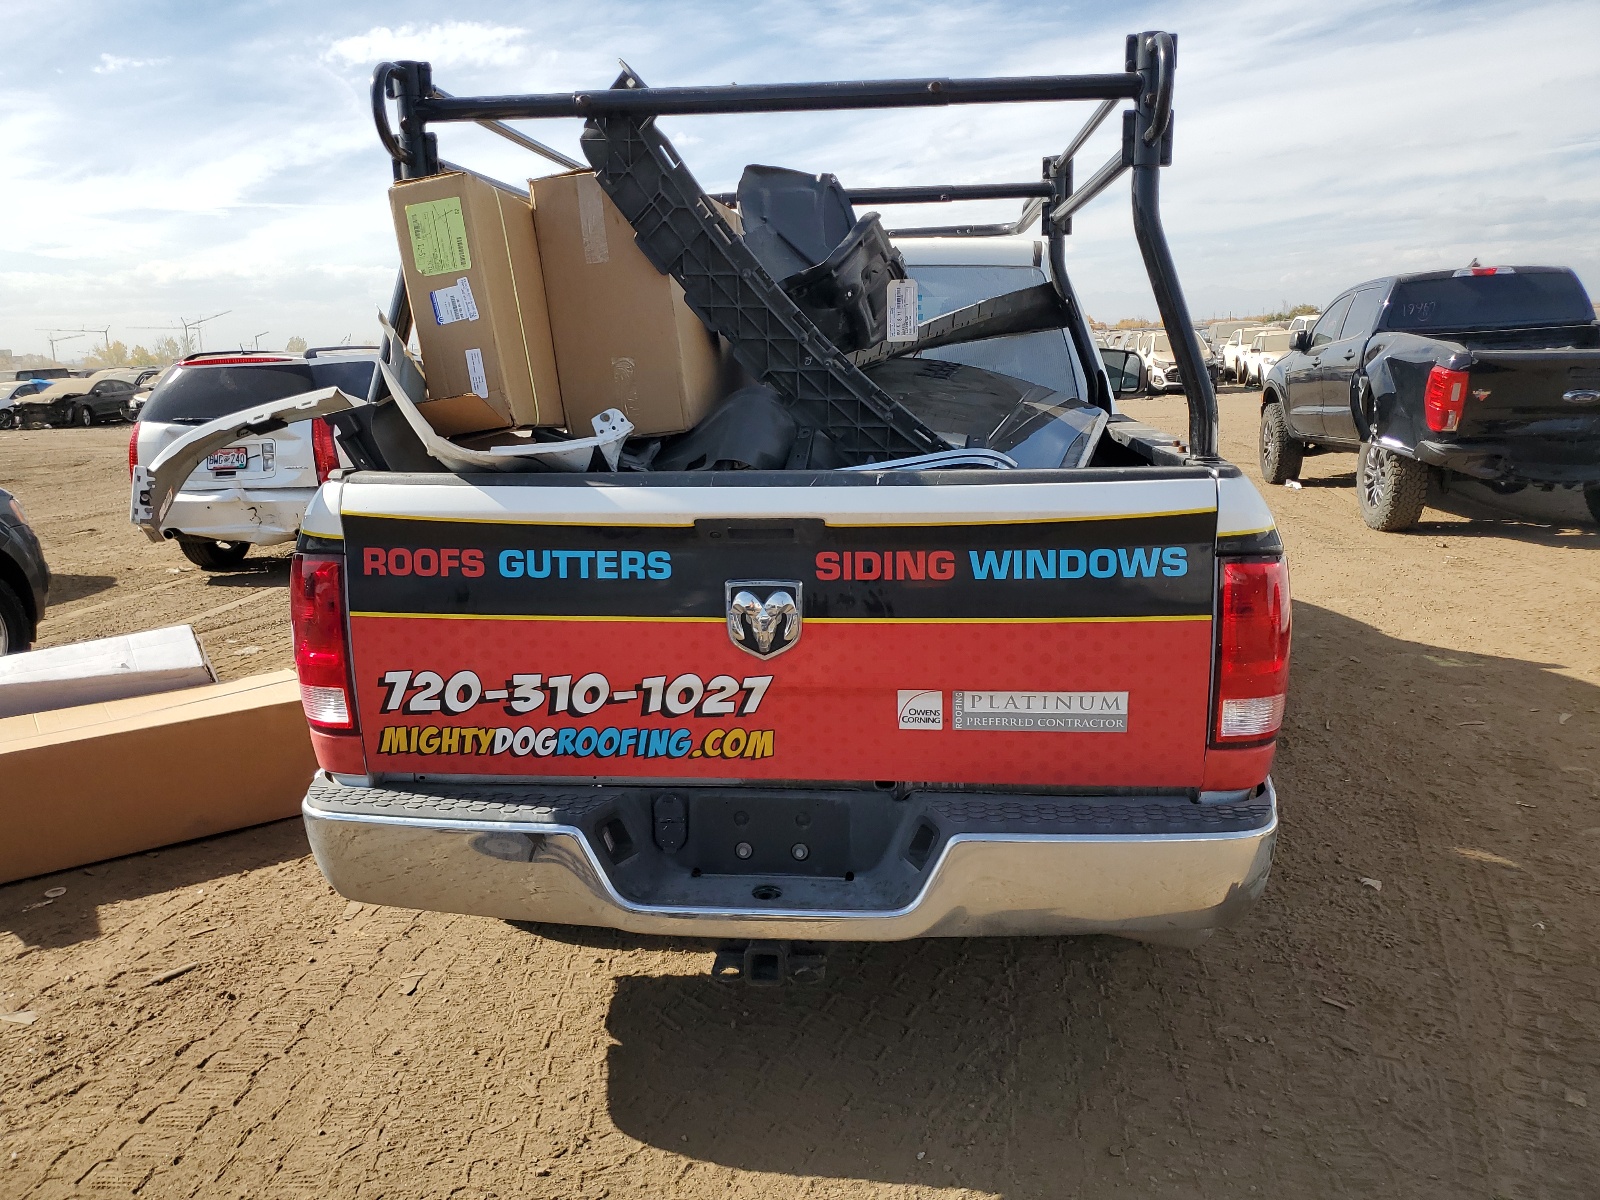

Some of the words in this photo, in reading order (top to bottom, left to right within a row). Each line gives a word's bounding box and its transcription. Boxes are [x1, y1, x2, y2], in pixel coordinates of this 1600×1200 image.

[363, 547, 485, 578] ROOFS
[498, 549, 672, 580] GUTTERS
[815, 550, 955, 581] SIDING
[969, 547, 1188, 580] WINDOWS
[378, 670, 774, 717] 720-310-1027
[970, 694, 1122, 711] PLATINUM
[901, 716, 941, 724] CORNING
[908, 707, 941, 717] OWENS
[955, 692, 963, 729] ROOFING
[966, 717, 1034, 728] PREFERRED
[1037, 718, 1125, 729] CONTRACTOR
[378, 725, 775, 760] MIGHTYDOGROOFING.COM
